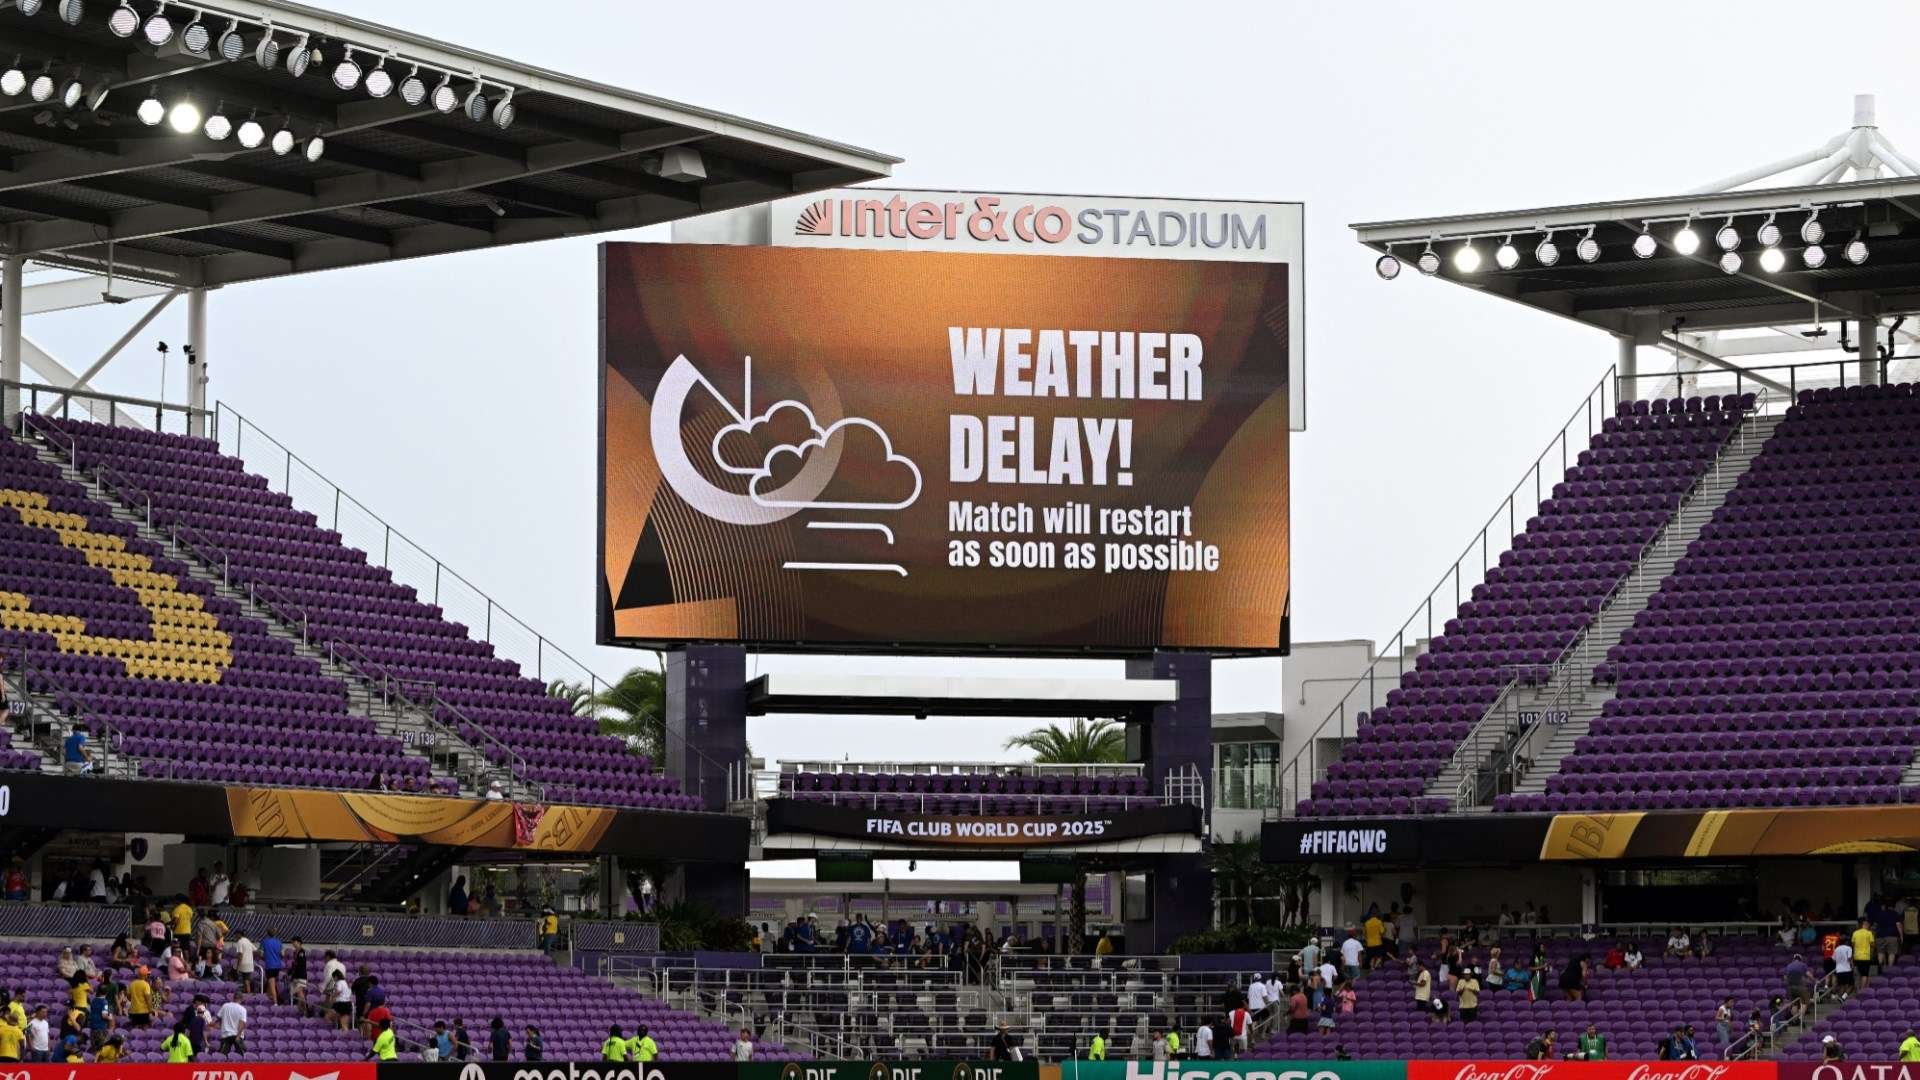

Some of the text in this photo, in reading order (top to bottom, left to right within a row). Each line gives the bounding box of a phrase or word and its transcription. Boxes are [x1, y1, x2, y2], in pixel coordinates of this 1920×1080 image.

[1077, 209, 1267, 250] STADIUM
[949, 326, 1203, 401] WEATHER
[950, 414, 1133, 486] DELAY!
[949, 501, 1192, 536] Match will restart
[949, 538, 1219, 573] as soon as possible
[8, 701, 25, 714] 137
[1547, 712, 1568, 724] 102
[420, 733, 435, 745] 138
[866, 818, 904, 835] FIFA
[907, 821, 951, 836] CLUB
[956, 821, 1019, 837] WORLD
[1023, 822, 1057, 837] CUP
[1299, 829, 1387, 854] #FIFACWC
